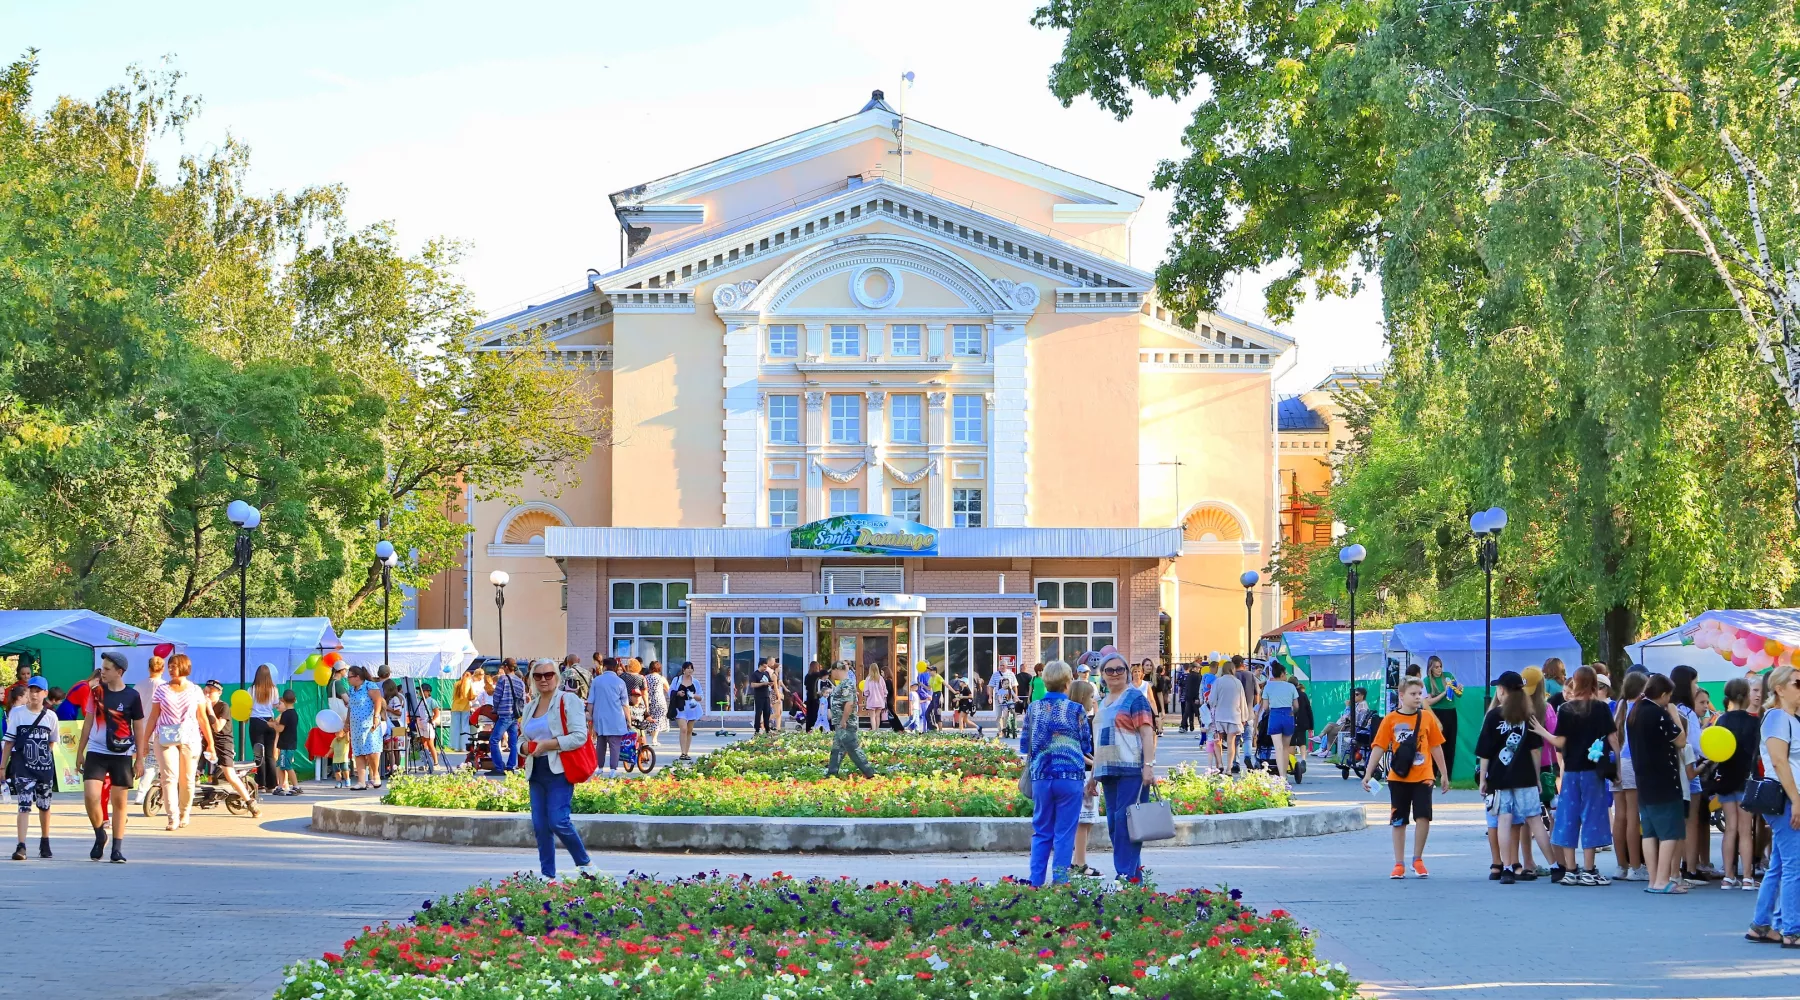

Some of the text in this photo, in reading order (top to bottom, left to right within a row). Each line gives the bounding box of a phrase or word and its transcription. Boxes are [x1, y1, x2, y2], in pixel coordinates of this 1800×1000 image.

[814, 528, 935, 551] Santa Domingo
[847, 597, 881, 607] КАФЕ
